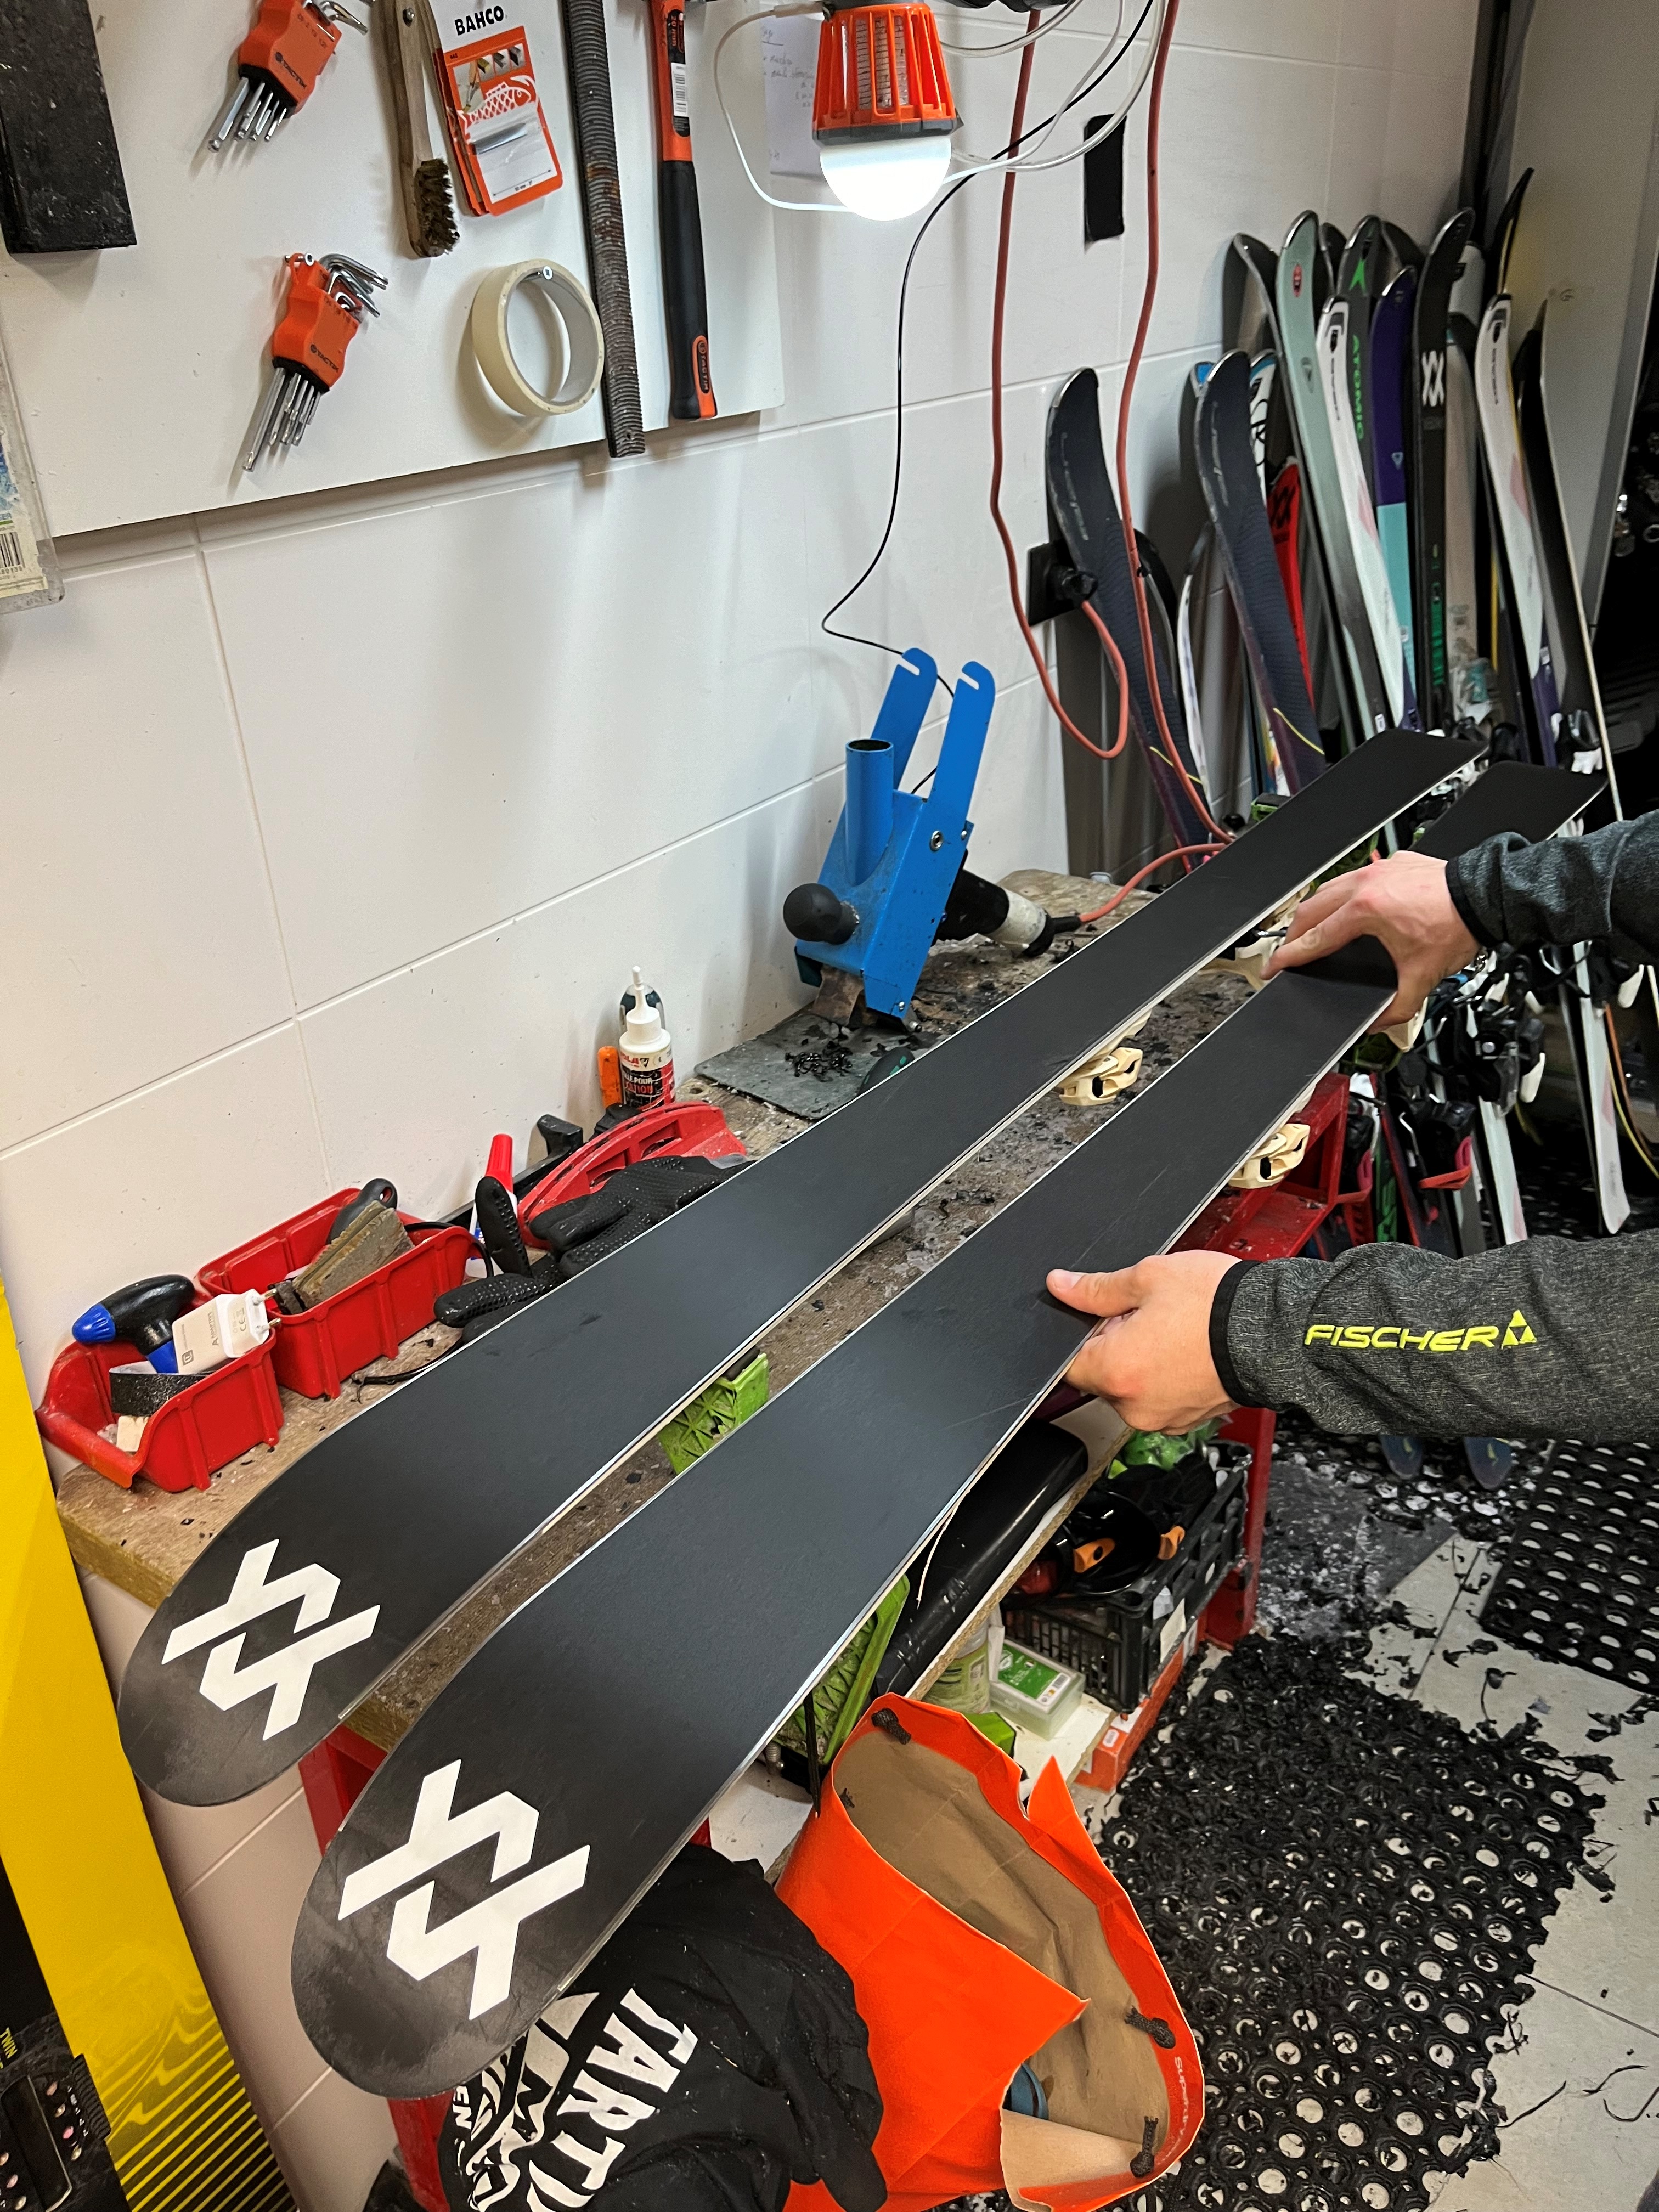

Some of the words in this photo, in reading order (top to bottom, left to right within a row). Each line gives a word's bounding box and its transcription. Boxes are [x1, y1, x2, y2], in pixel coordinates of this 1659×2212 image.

[454, 5, 504, 36] BAHCO
[1304, 1324, 1499, 1352] FISCHER
[0, 2027, 18, 2059] TWIN
[1174, 2056, 1189, 2136] Superdry
